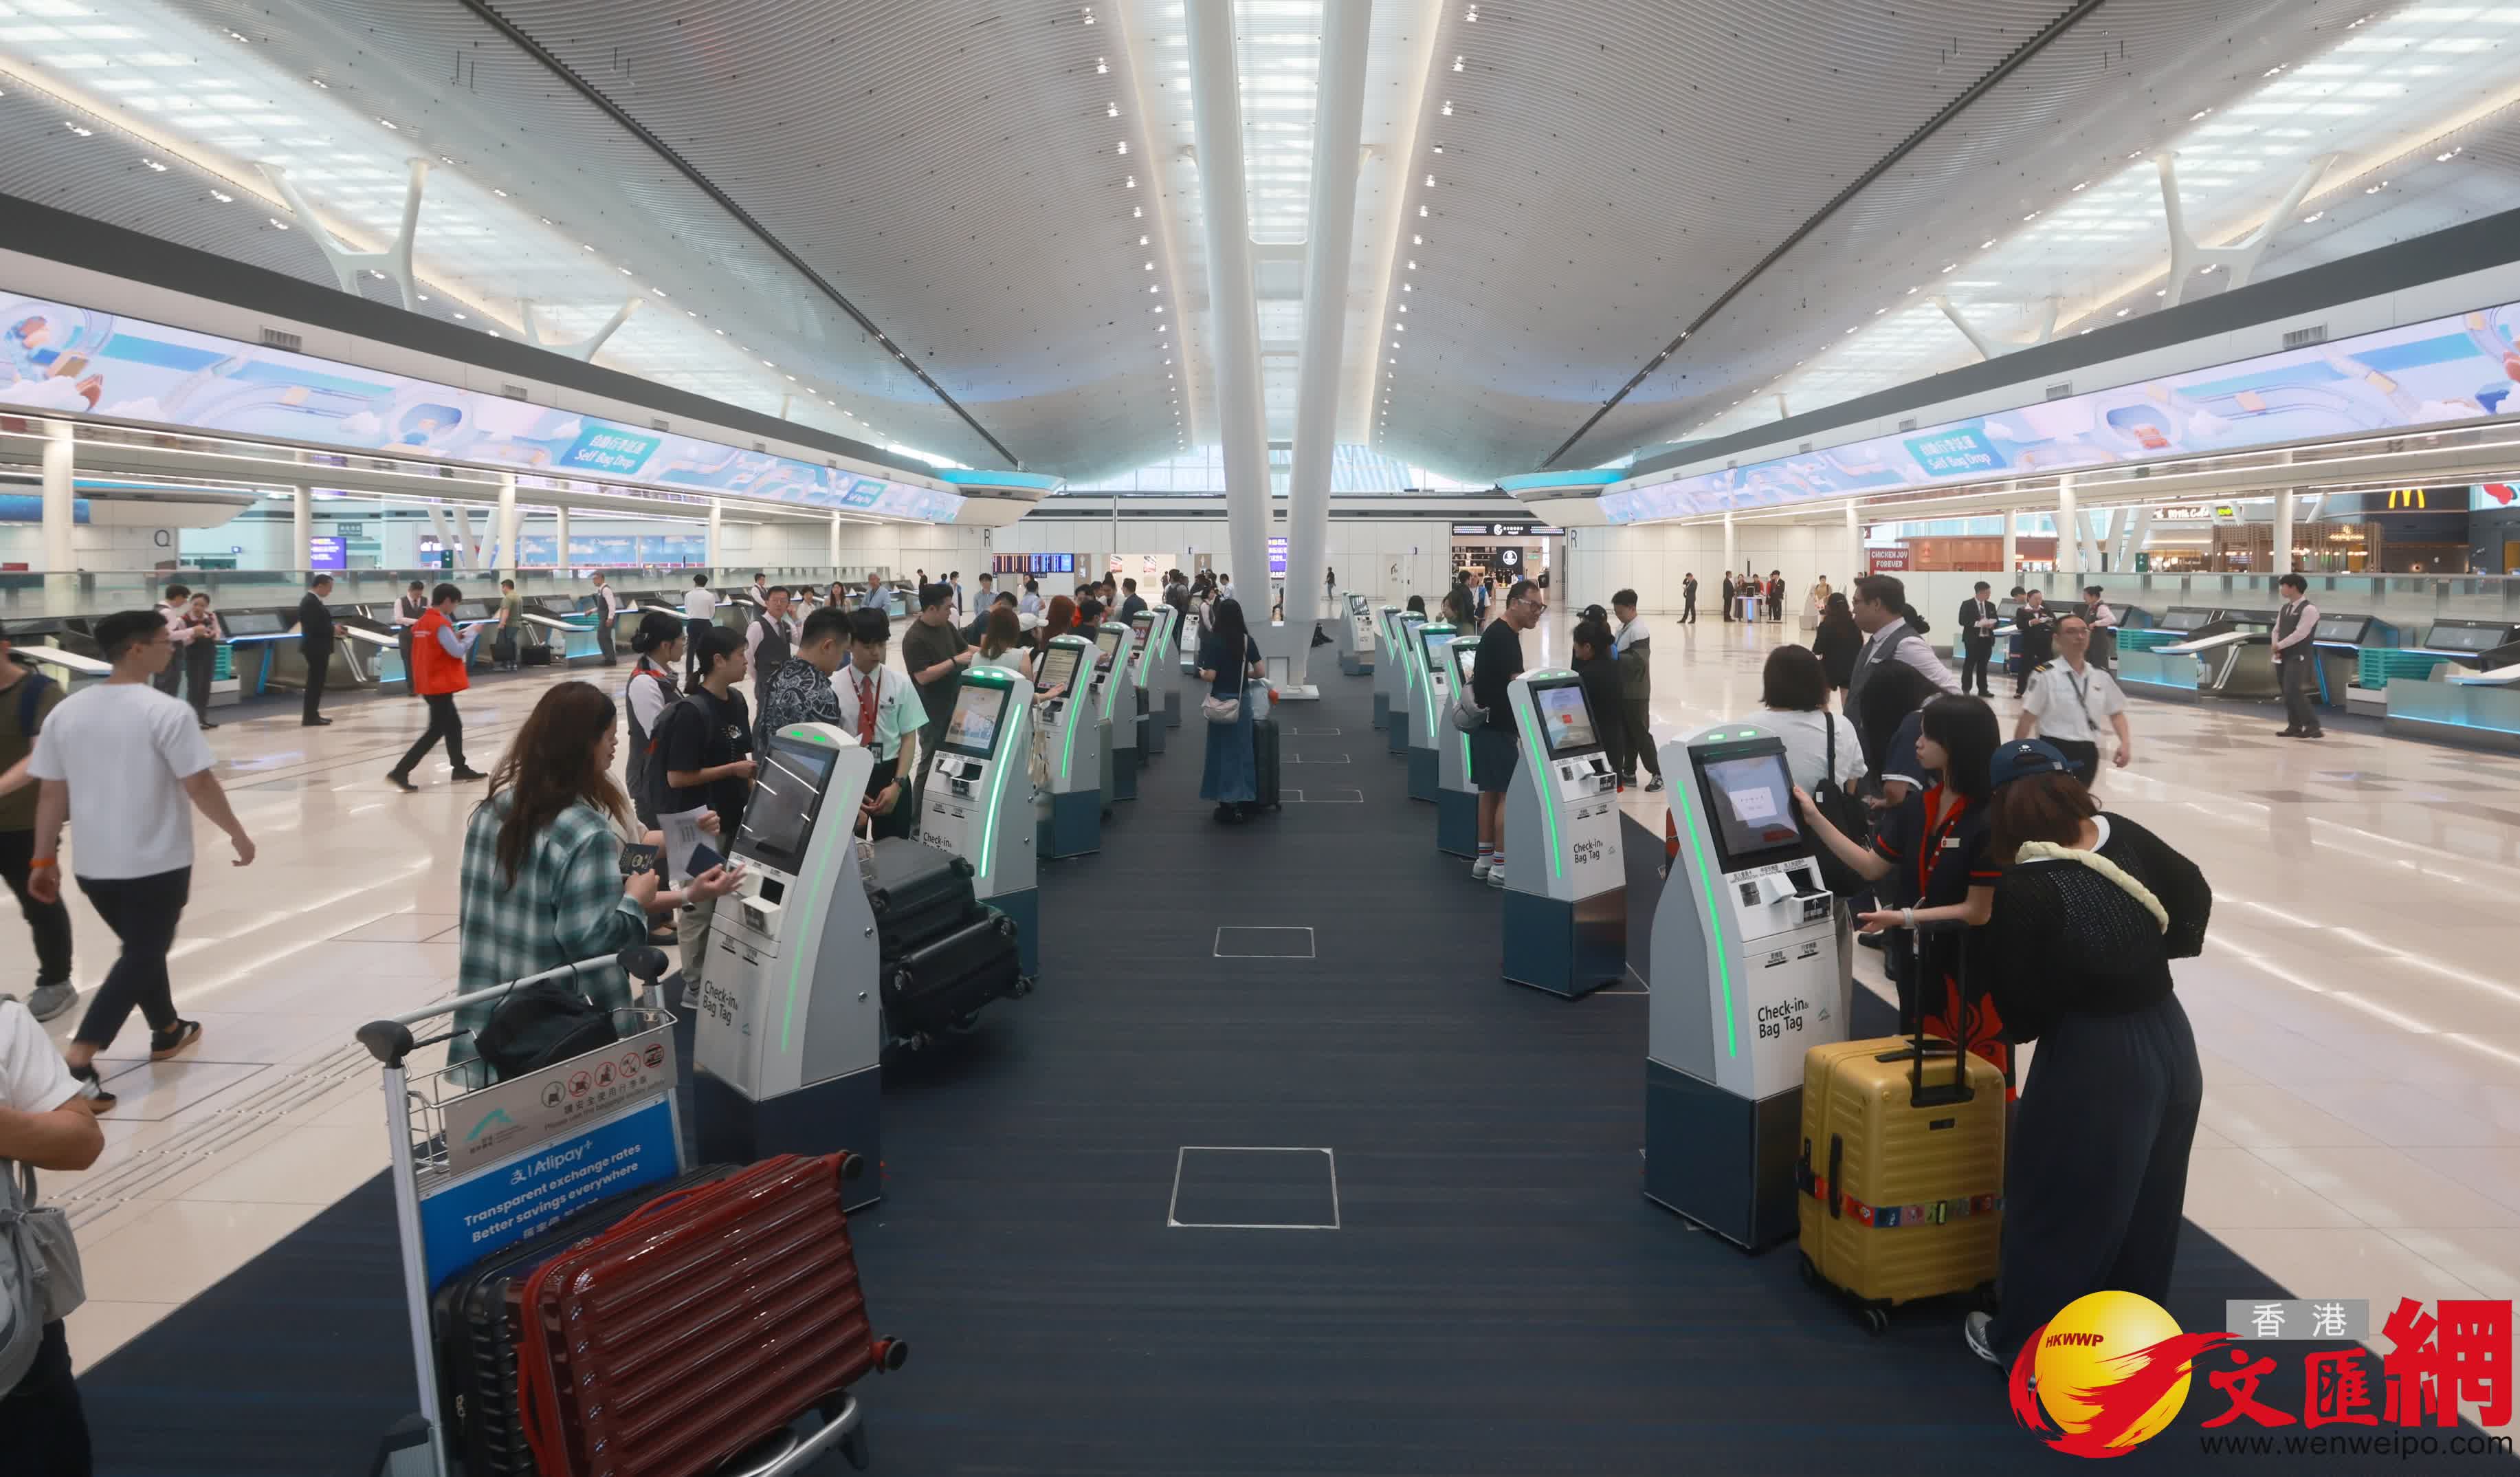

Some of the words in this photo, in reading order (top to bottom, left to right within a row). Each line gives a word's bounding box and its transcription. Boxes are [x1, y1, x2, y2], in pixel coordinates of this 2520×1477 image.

[574, 448, 599, 462] Self
[1927, 455, 1947, 470] Self
[153, 529, 171, 547] Q
[984, 528, 991, 547] R
[1571, 529, 1578, 549] R
[1876, 560, 1903, 569] FOREVER
[1575, 853, 1587, 864] Bag
[1589, 850, 1600, 861] Tag
[703, 994, 716, 1018] Bag
[720, 1003, 732, 1027] Tag
[1758, 1022, 1780, 1039] Bag
[1783, 1015, 1803, 1032] Tag
[463, 1181, 549, 1227] Transparent
[549, 1157, 611, 1190] exchange
[610, 1143, 641, 1166] rates
[472, 1217, 514, 1243] Better
[516, 1193, 567, 1224] savings
[568, 1161, 639, 1200] everywhere
